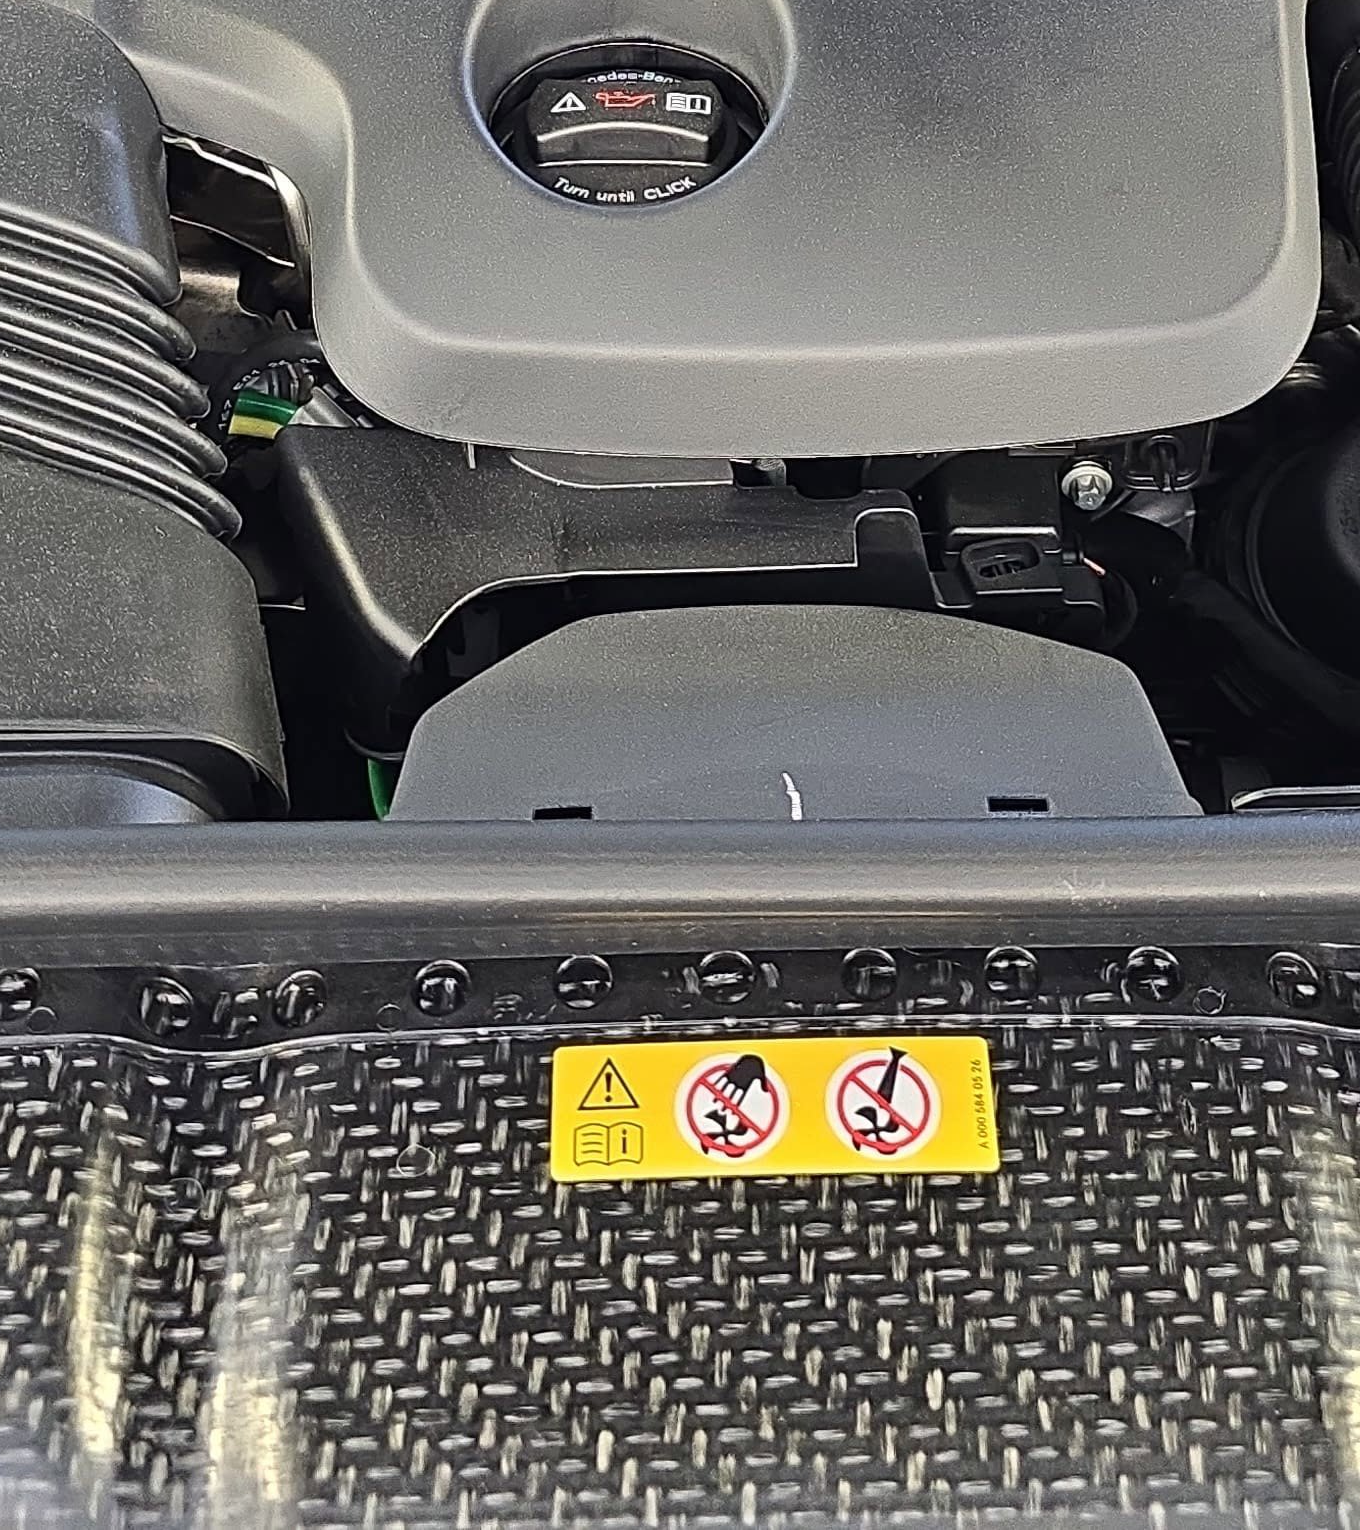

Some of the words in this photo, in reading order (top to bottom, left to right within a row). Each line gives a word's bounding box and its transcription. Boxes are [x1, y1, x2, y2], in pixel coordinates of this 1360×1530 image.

[581, 71, 683, 84] cedes-Ben
[553, 176, 590, 200] Turn
[596, 188, 636, 203] until
[643, 176, 697, 202] CLICK
[969, 1058, 983, 1073] 26
[971, 1075, 984, 1090] 05
[976, 1116, 989, 1139] 000
[977, 1141, 990, 1150] A
